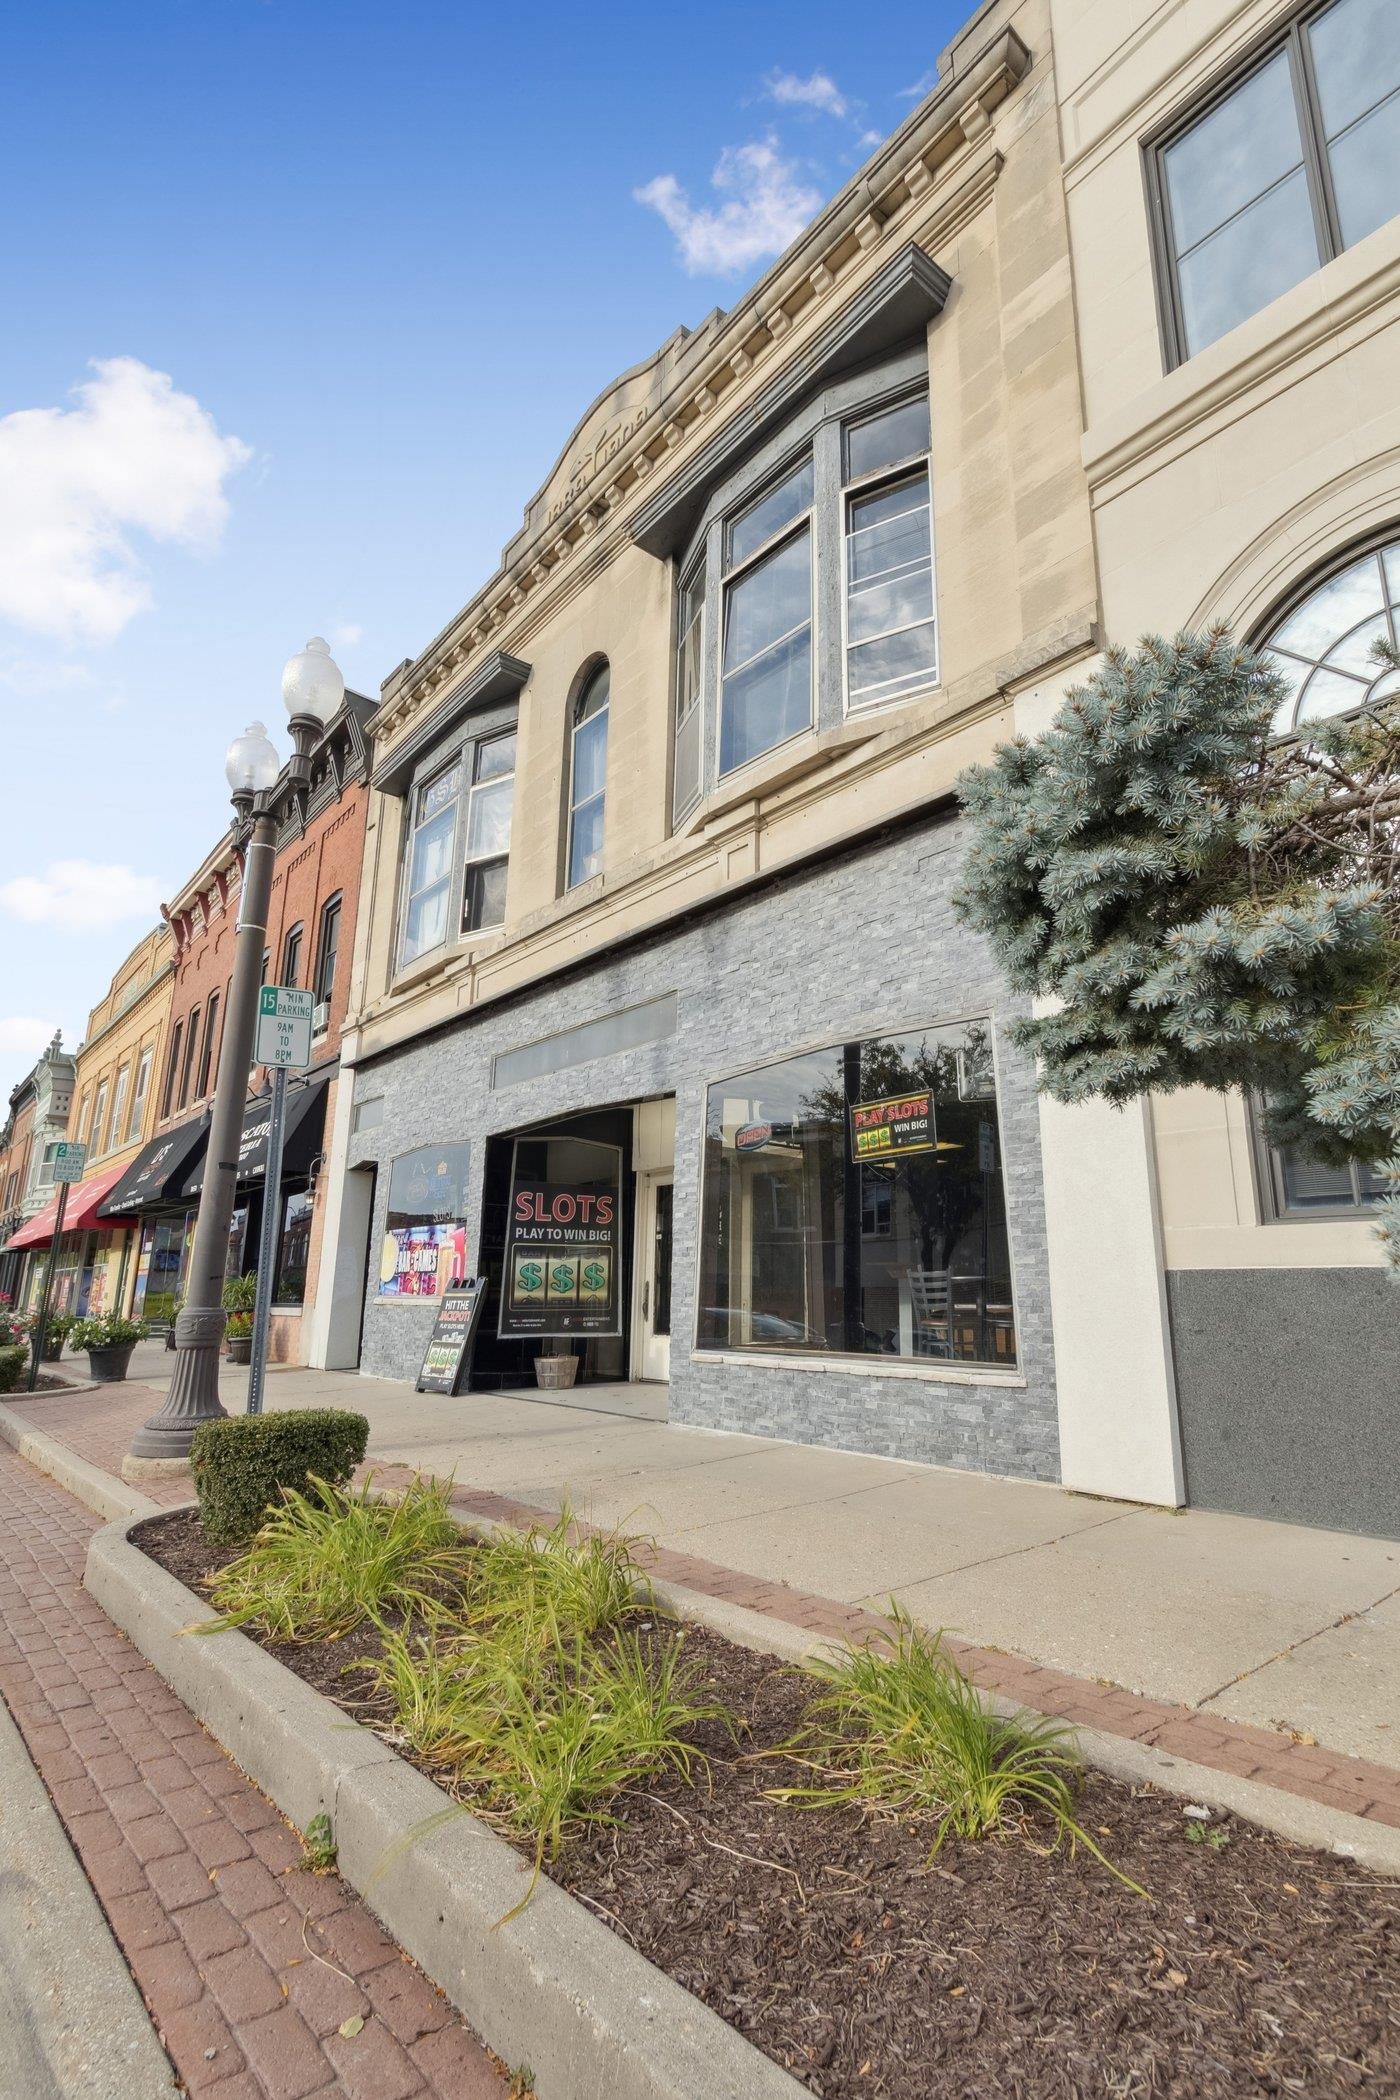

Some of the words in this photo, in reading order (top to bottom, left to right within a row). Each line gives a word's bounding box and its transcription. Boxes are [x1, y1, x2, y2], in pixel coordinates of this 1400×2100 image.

[263, 993, 276, 1009] 15
[287, 993, 304, 1004] MIN
[277, 1003, 310, 1017] PARKING
[277, 1022, 294, 1033] 9AM
[280, 1036, 289, 1046] TO
[275, 1050, 292, 1061] 8PM
[855, 1107, 885, 1128] PLAY
[887, 1099, 929, 1121] SLOTS
[894, 1122, 910, 1133] WIN
[911, 1119, 928, 1130] BIG!
[58, 1144, 67, 1156] 2
[515, 1191, 614, 1225] SLOTS
[515, 1227, 545, 1239] PLAY
[546, 1228, 562, 1240] TO
[564, 1228, 587, 1241] WIN
[588, 1229, 612, 1242] BIG!
[445, 1300, 455, 1310] HIT
[455, 1300, 469, 1310] THE
